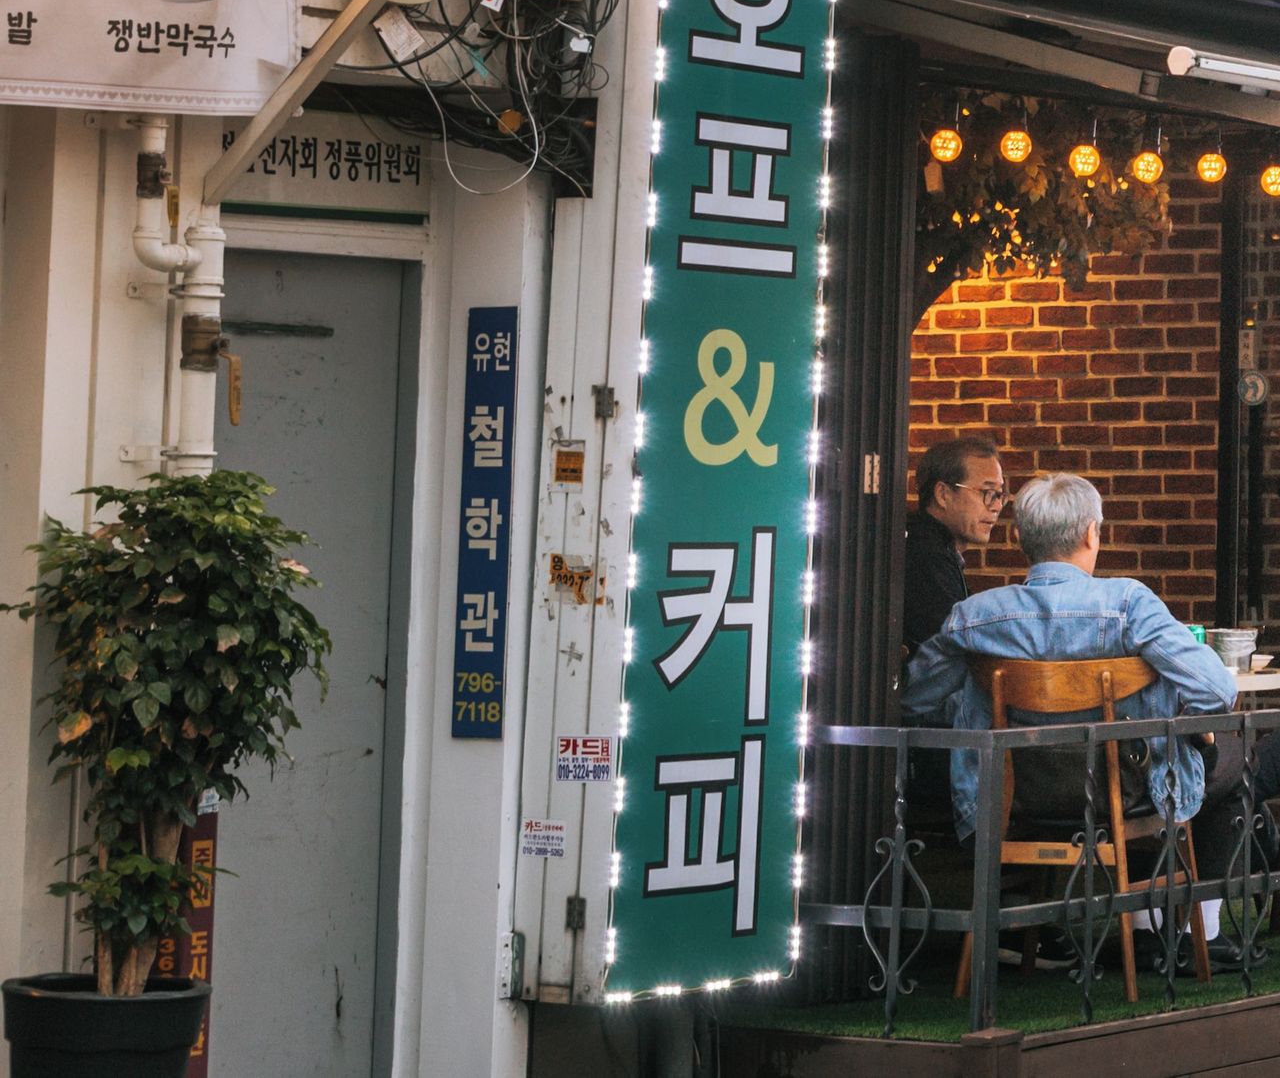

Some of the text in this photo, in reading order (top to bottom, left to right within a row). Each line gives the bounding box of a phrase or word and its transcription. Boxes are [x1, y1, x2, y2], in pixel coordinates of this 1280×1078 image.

[107, 18, 237, 59] 쟁반막국수
[324, 139, 422, 186] 정풍위원회
[471, 332, 511, 372] 유현
[681, 327, 779, 470] &
[459, 405, 505, 654] 철학관
[457, 671, 502, 694] 796-
[455, 701, 501, 723] 7118
[641, 523, 778, 936] 커피
[560, 738, 600, 756] 카드
[525, 820, 543, 833] 카드
